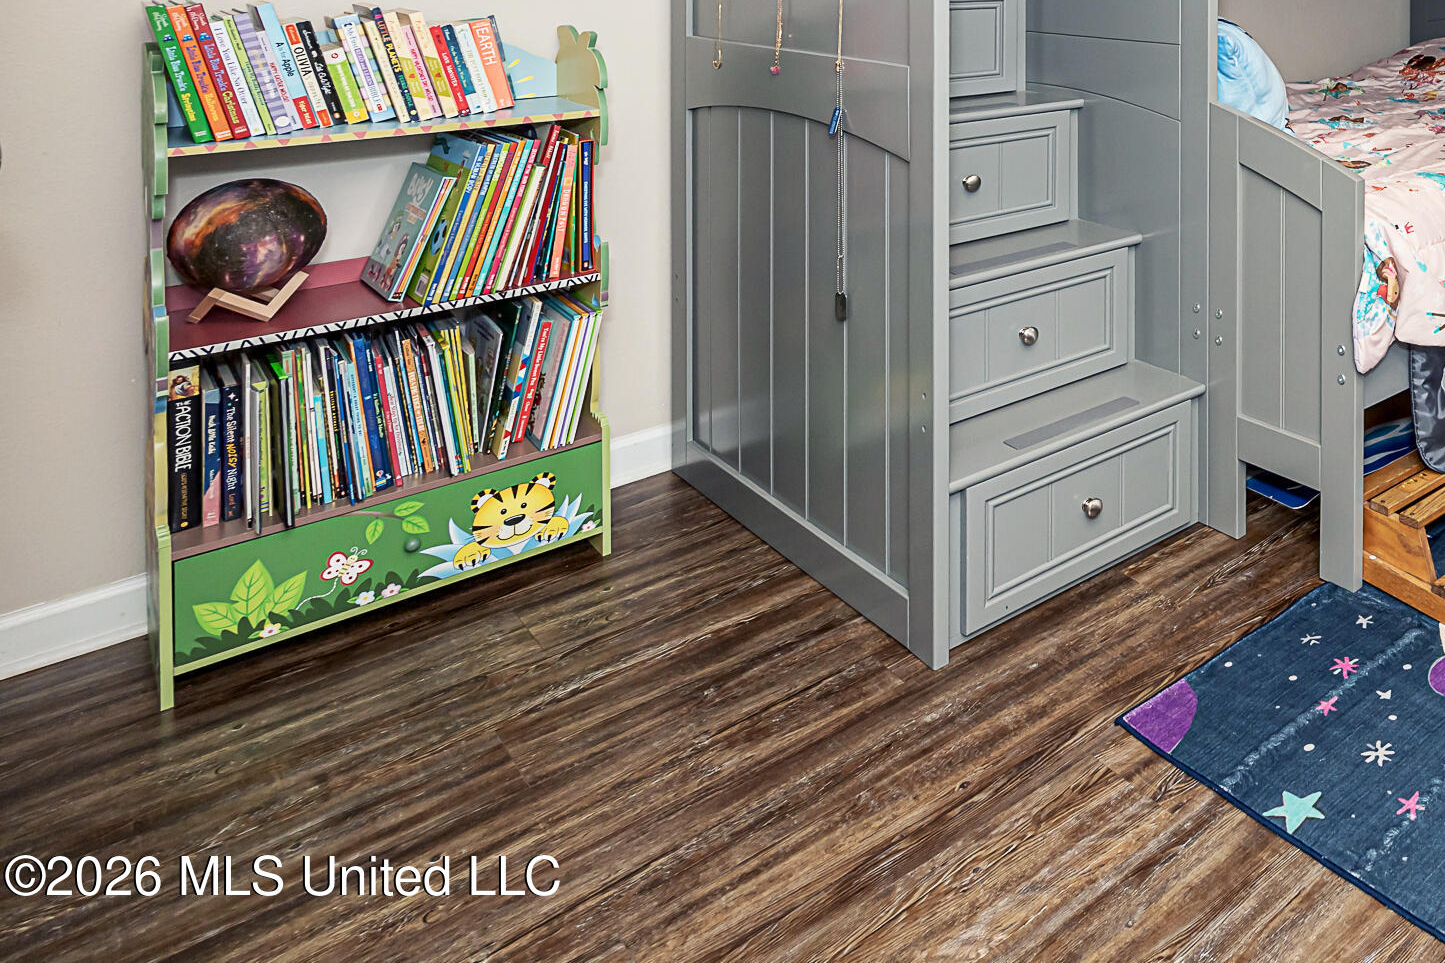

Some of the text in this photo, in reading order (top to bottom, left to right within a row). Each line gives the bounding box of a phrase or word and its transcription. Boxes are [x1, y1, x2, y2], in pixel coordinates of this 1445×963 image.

[165, 46, 178, 60] Little
[186, 45, 199, 59] Little
[377, 21, 389, 41] LITTLE
[385, 43, 401, 72] PLANETS
[476, 28, 496, 65] EARTH
[170, 60, 181, 71] Blue
[192, 60, 203, 71] Blue
[216, 32, 227, 48] Love
[222, 49, 232, 62] You
[227, 62, 238, 75] Like
[233, 77, 241, 86] No
[281, 59, 295, 77] Apple
[174, 72, 189, 91] Truck's
[204, 43, 241, 123] Little Blue Truck's Christmas
[368, 86, 380, 104] BIBLE
[539, 326, 549, 342] You're
[537, 342, 545, 350] My
[531, 363, 539, 377] Sweet
[226, 406, 235, 420] The
[174, 405, 192, 446] ACTION
[226, 420, 236, 443] Silent
[174, 445, 192, 472] BIBLE
[225, 443, 237, 467] NOISY
[226, 468, 236, 490] Night
